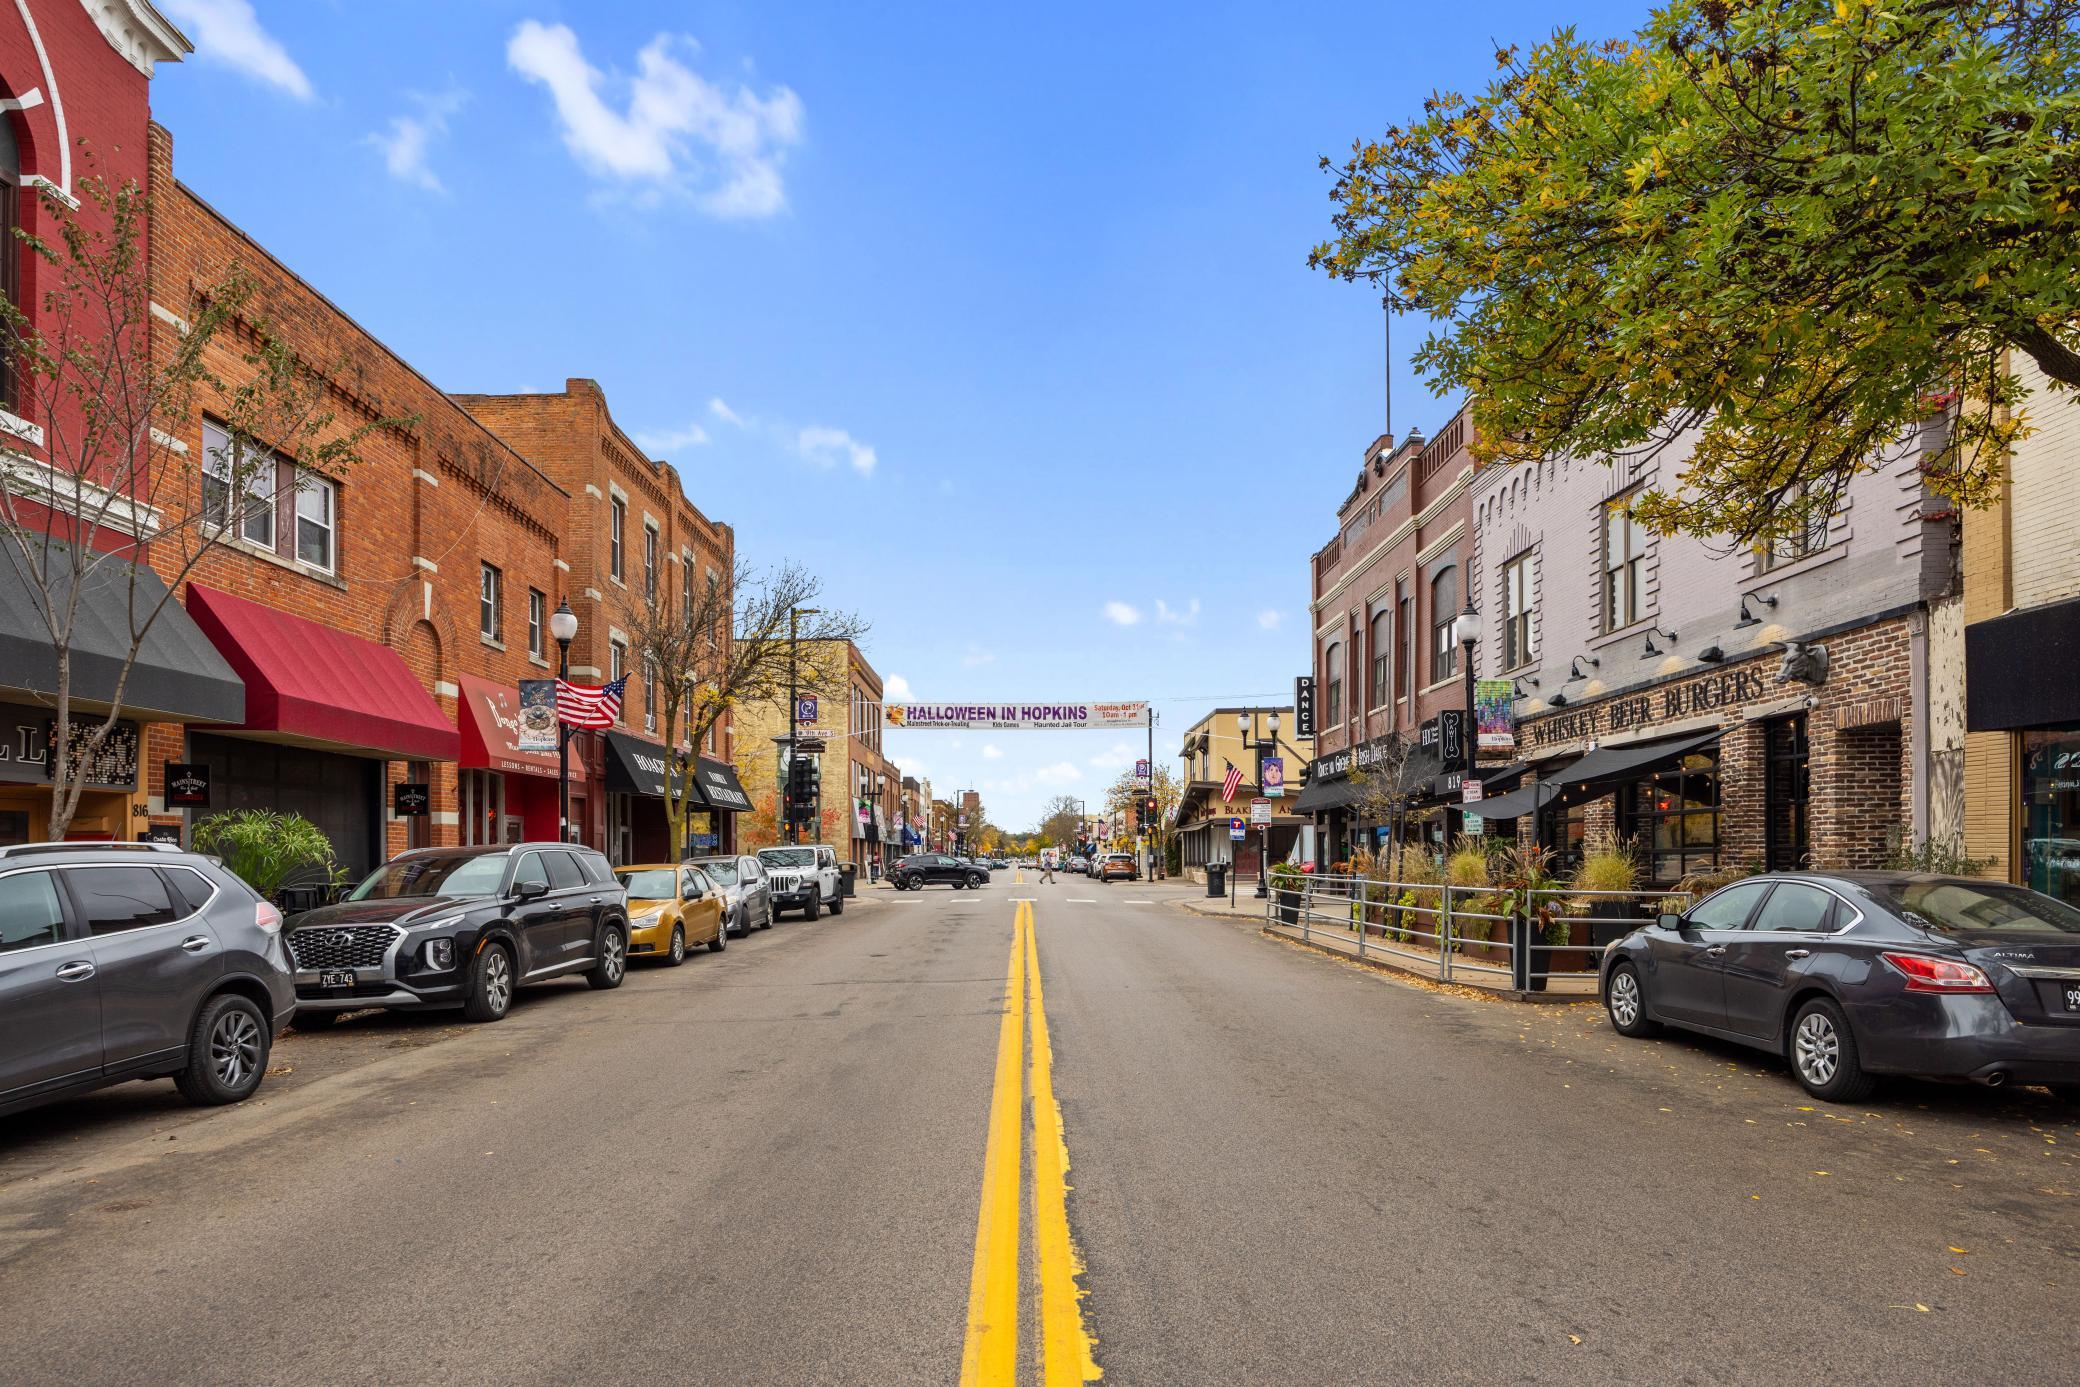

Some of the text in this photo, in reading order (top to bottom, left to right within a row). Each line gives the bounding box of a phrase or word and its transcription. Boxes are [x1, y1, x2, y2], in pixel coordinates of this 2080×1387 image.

[1301, 679, 1310, 731] DANCE
[1533, 667, 1764, 744] WHISKEY BEER BURGERS
[907, 706, 1087, 720] HALLOWEEN IN HOPKINS
[501, 760, 521, 770] LESSONS
[525, 765, 543, 775] RENTALS
[547, 768, 559, 776] SALES
[1447, 775, 1460, 789] 819
[133, 804, 149, 817] 816
[340, 974, 353, 983] 743
